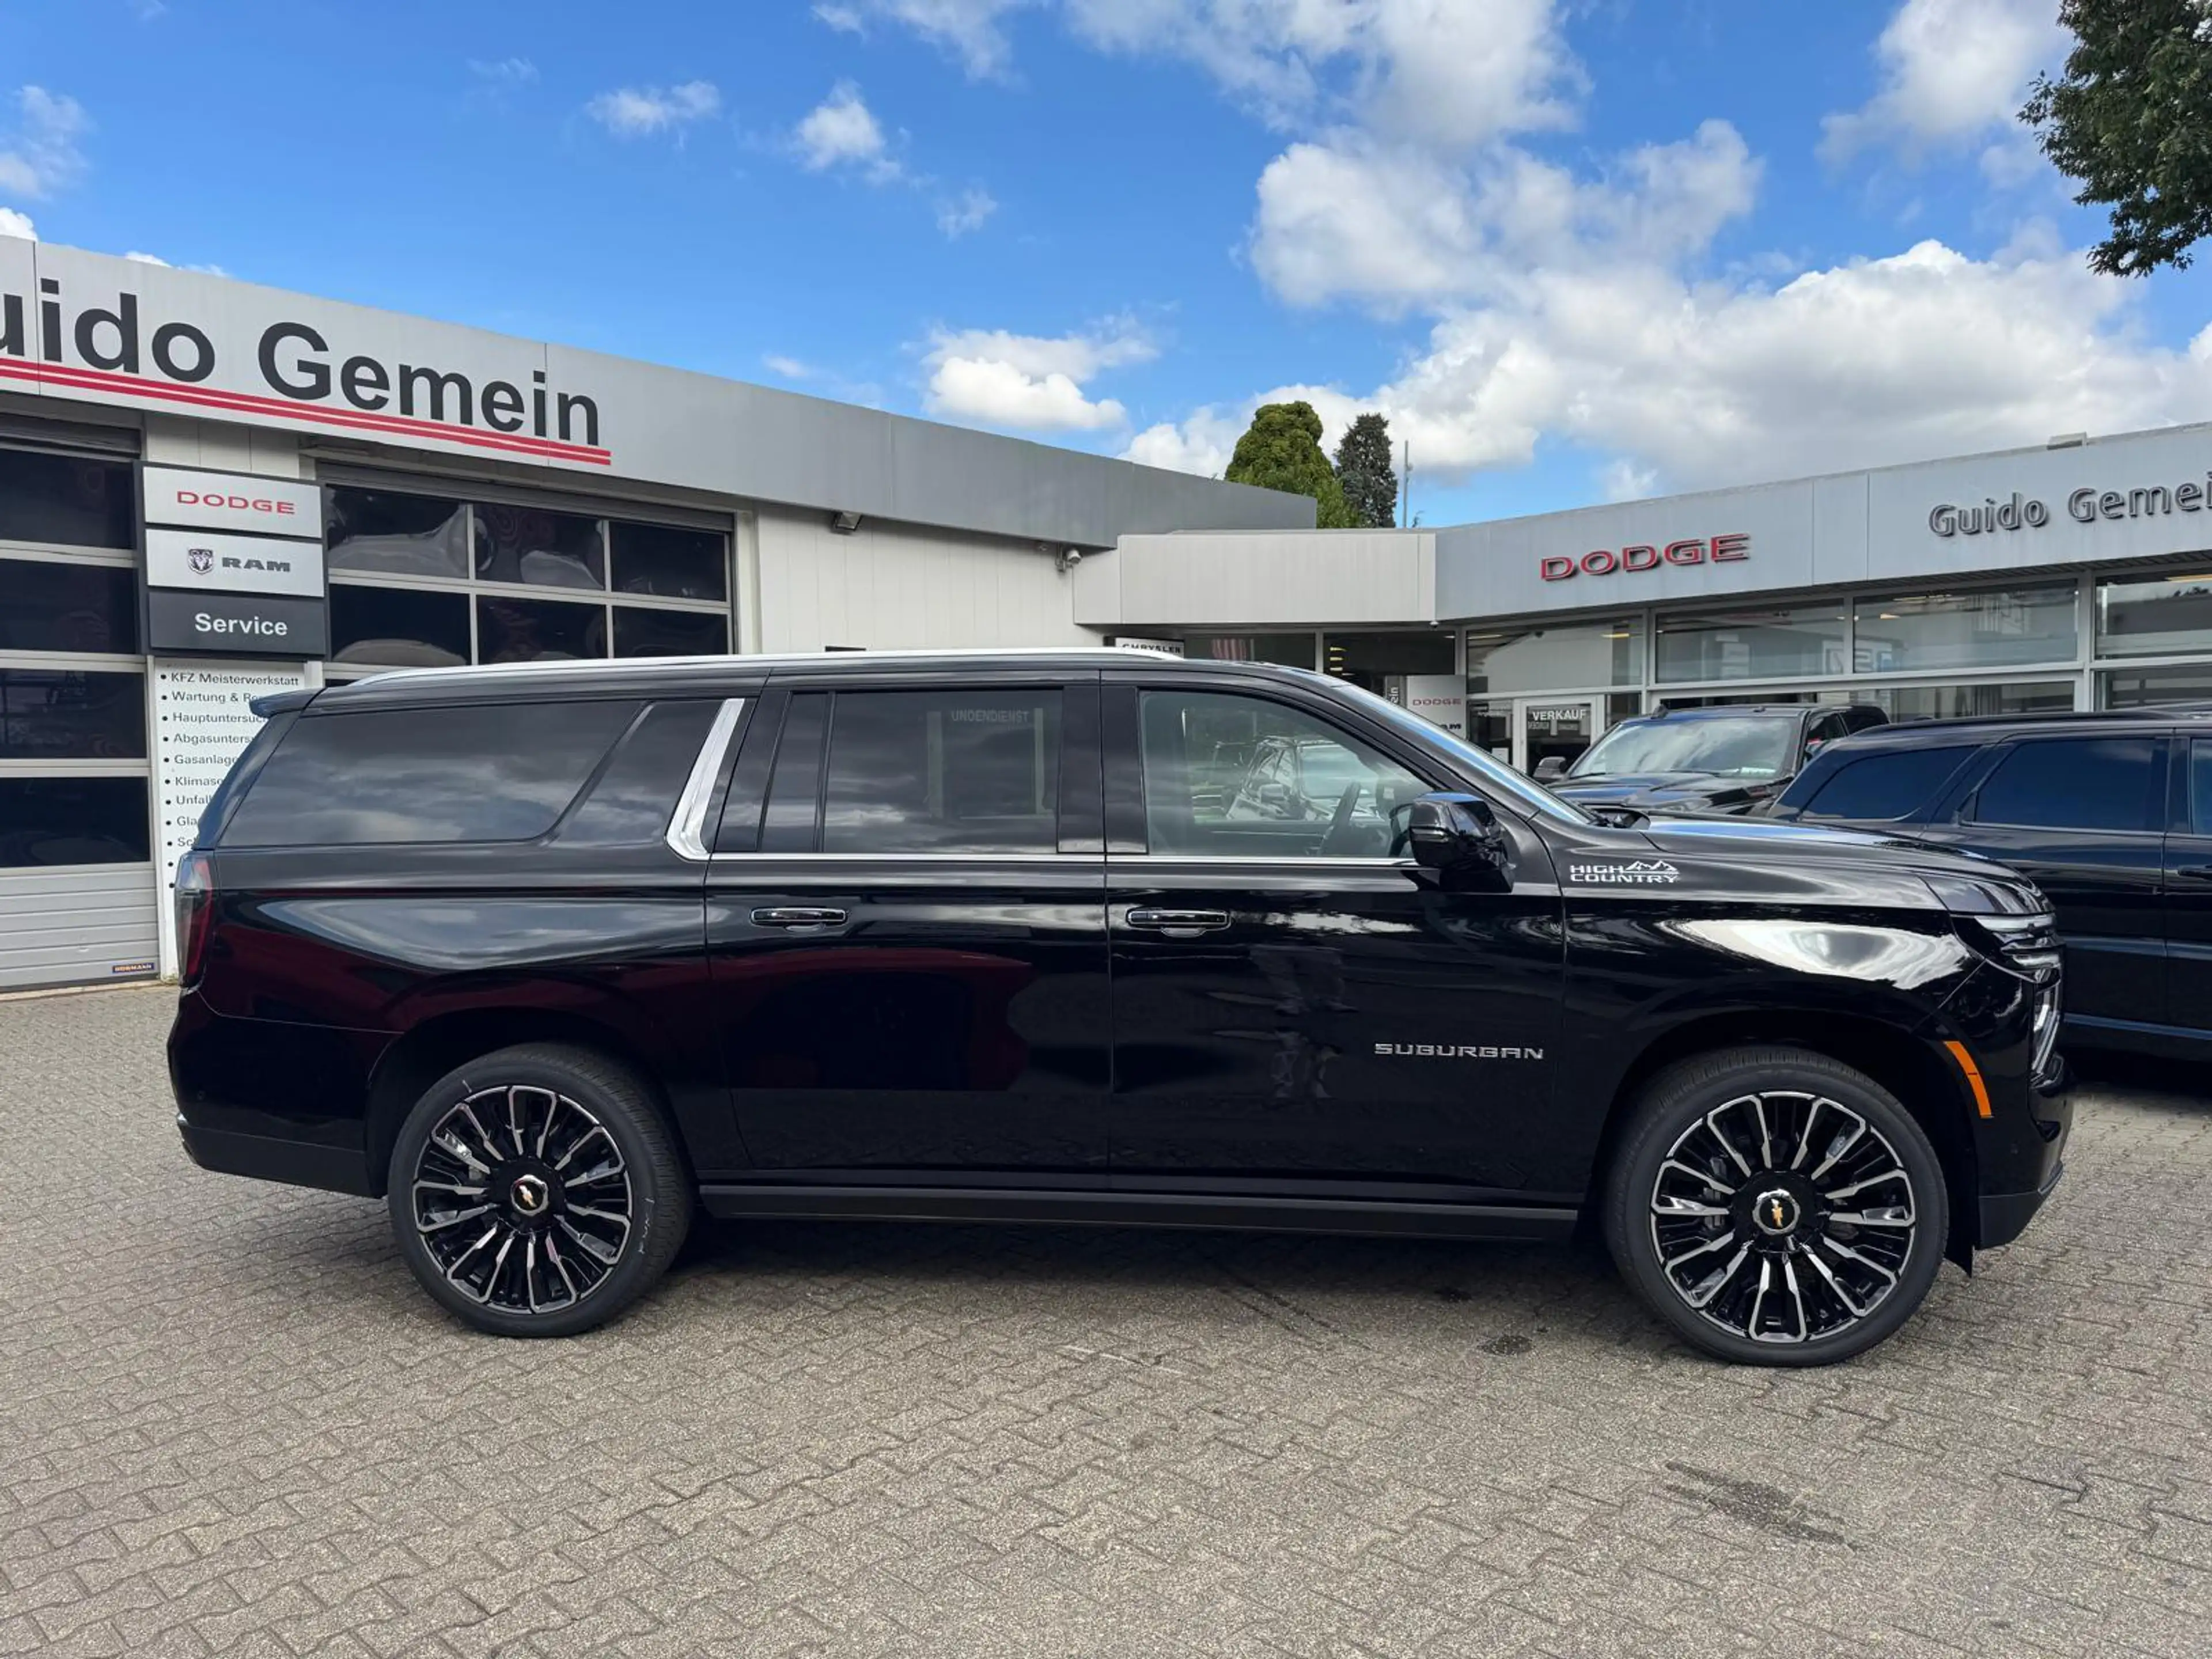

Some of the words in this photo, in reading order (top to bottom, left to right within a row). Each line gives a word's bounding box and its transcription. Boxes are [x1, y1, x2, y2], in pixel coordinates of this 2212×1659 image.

[258, 322, 599, 445] Gemein
[177, 491, 295, 514] DODGE
[1929, 492, 2049, 536] Guido
[222, 556, 291, 573] RAM
[1541, 533, 1749, 581] DODGE
[195, 613, 288, 636] Service
[171, 673, 195, 683] KFZ
[199, 673, 299, 685] Meisterwerkstatt
[172, 692, 226, 704] Wartung
[230, 692, 238, 702] &
[1412, 698, 1462, 706] DODGE
[1532, 709, 1586, 721] VERKAUF
[1570, 865, 1624, 873] HIGH
[1570, 873, 1681, 883] COUNTRY
[1374, 1043, 1544, 1059] SUBURBAN
